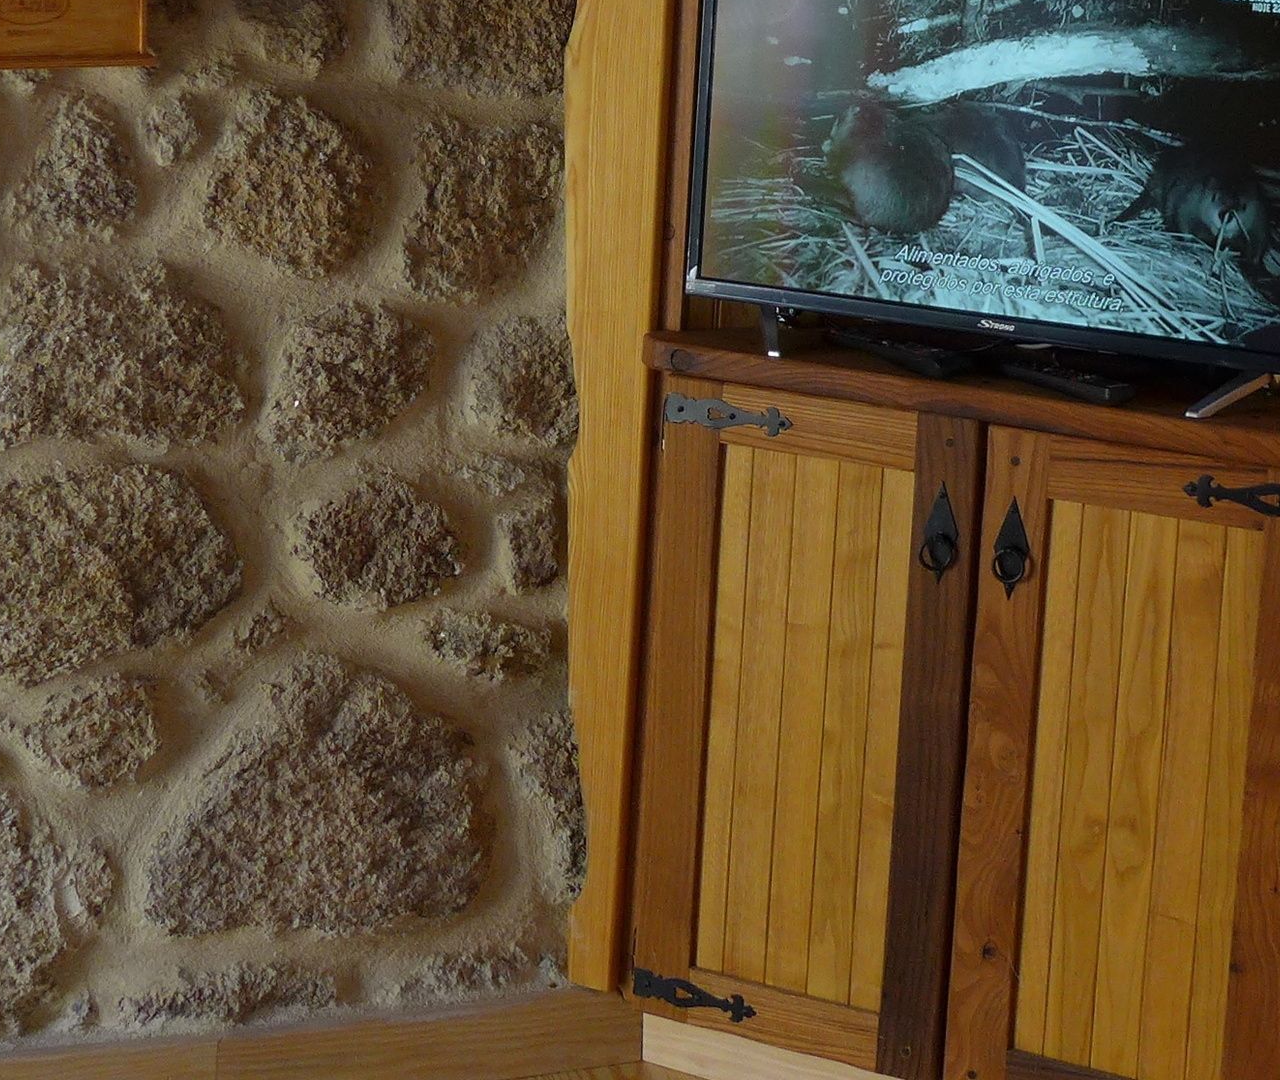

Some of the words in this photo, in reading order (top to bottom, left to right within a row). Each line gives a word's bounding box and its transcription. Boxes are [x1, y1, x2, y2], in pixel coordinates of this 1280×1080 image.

[1252, 3, 1271, 13] HOJE
[894, 244, 1002, 272] Alimentados,
[1007, 261, 1096, 287] abrigados,
[1102, 274, 1115, 286] e
[879, 269, 966, 290] protegidos
[970, 280, 1000, 295] por
[1003, 283, 1039, 301] esta
